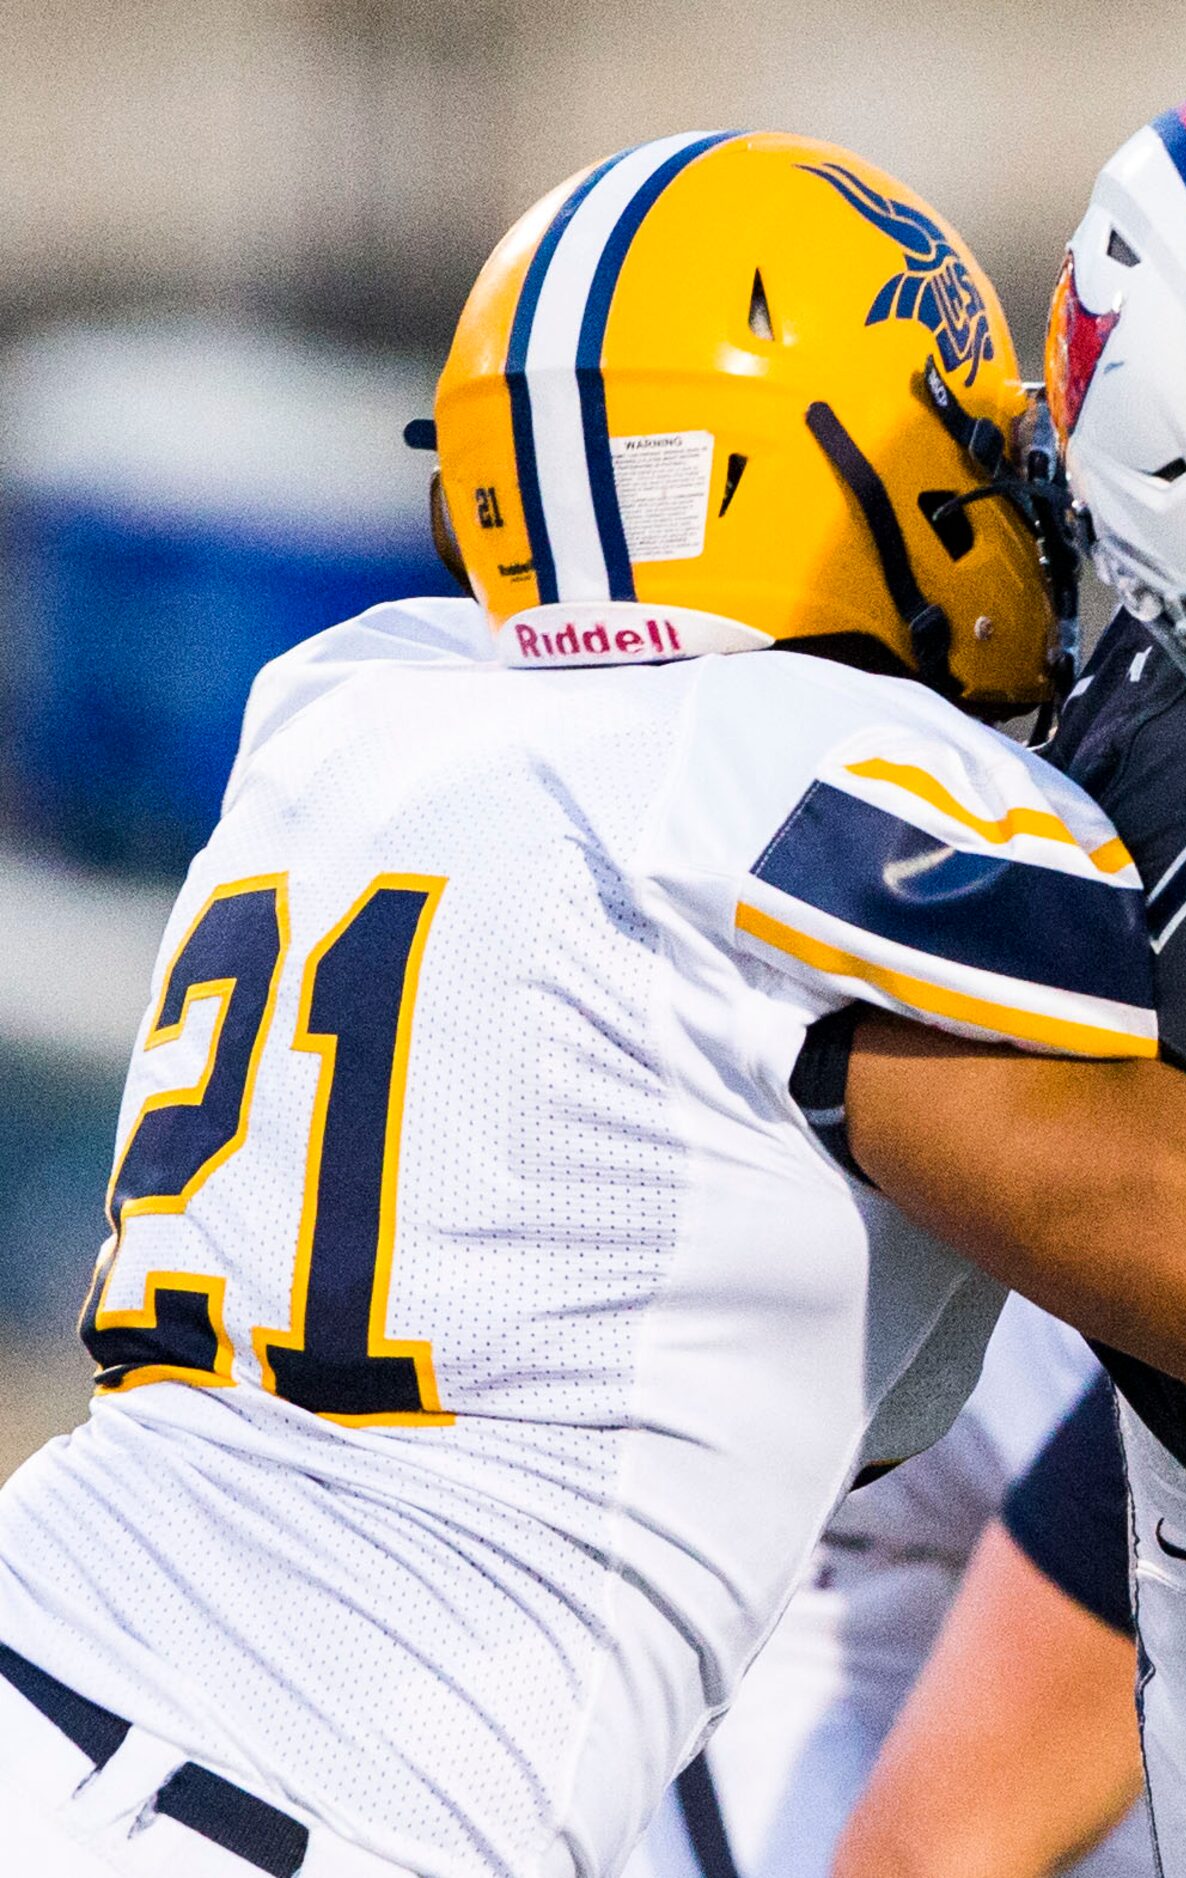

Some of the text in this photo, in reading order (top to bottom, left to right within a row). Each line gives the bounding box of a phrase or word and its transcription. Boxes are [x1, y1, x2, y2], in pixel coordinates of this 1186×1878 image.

[624, 437, 683, 450] WARNING
[475, 487, 504, 529] 21
[515, 619, 682, 658] Riddell
[78, 870, 457, 1428] 21
